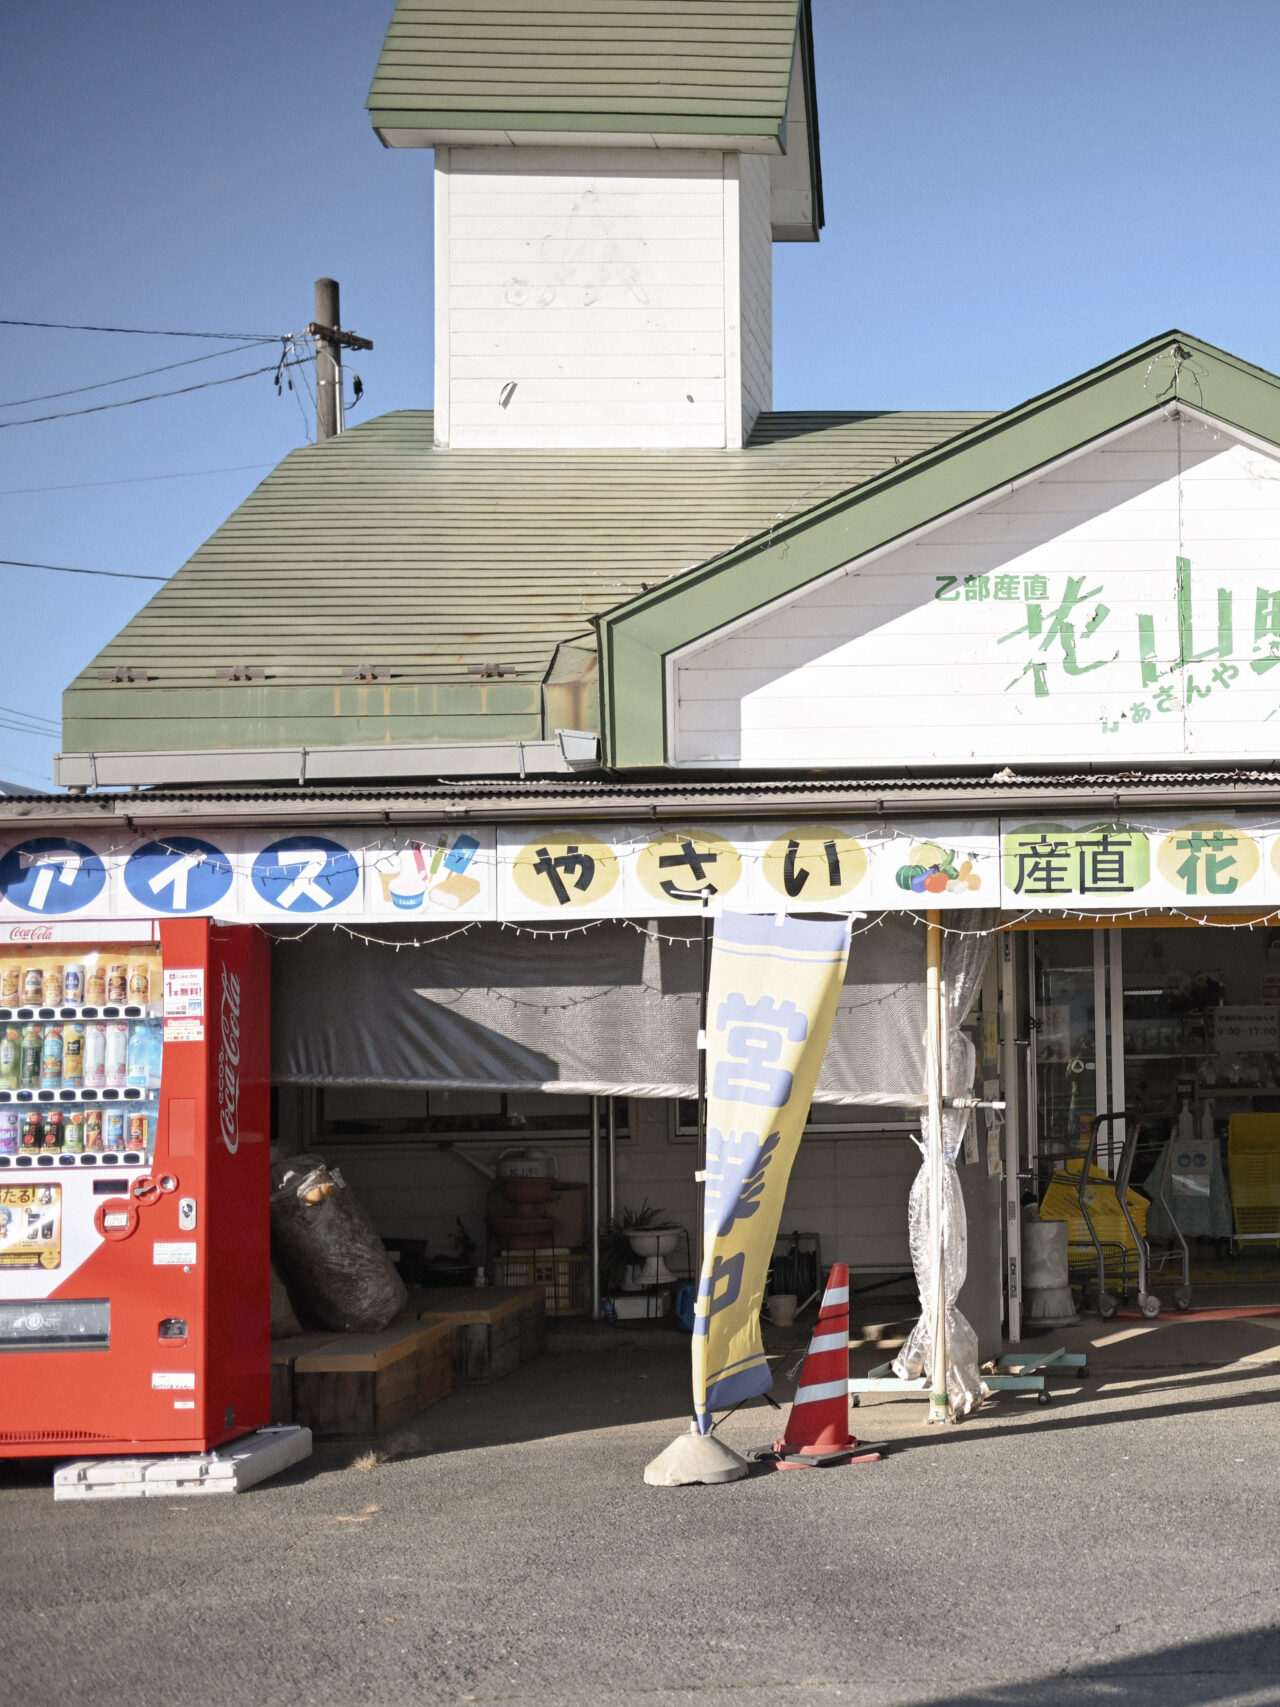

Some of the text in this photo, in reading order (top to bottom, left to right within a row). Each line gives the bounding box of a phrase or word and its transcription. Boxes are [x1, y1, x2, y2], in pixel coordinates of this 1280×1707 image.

[934, 573, 1050, 602] 乙部産直
[19, 848, 334, 911] アイス
[532, 838, 842, 906] やさい
[219, 960, 242, 1156] Coca-Cola
[0, 1187, 36, 1204] たる!
